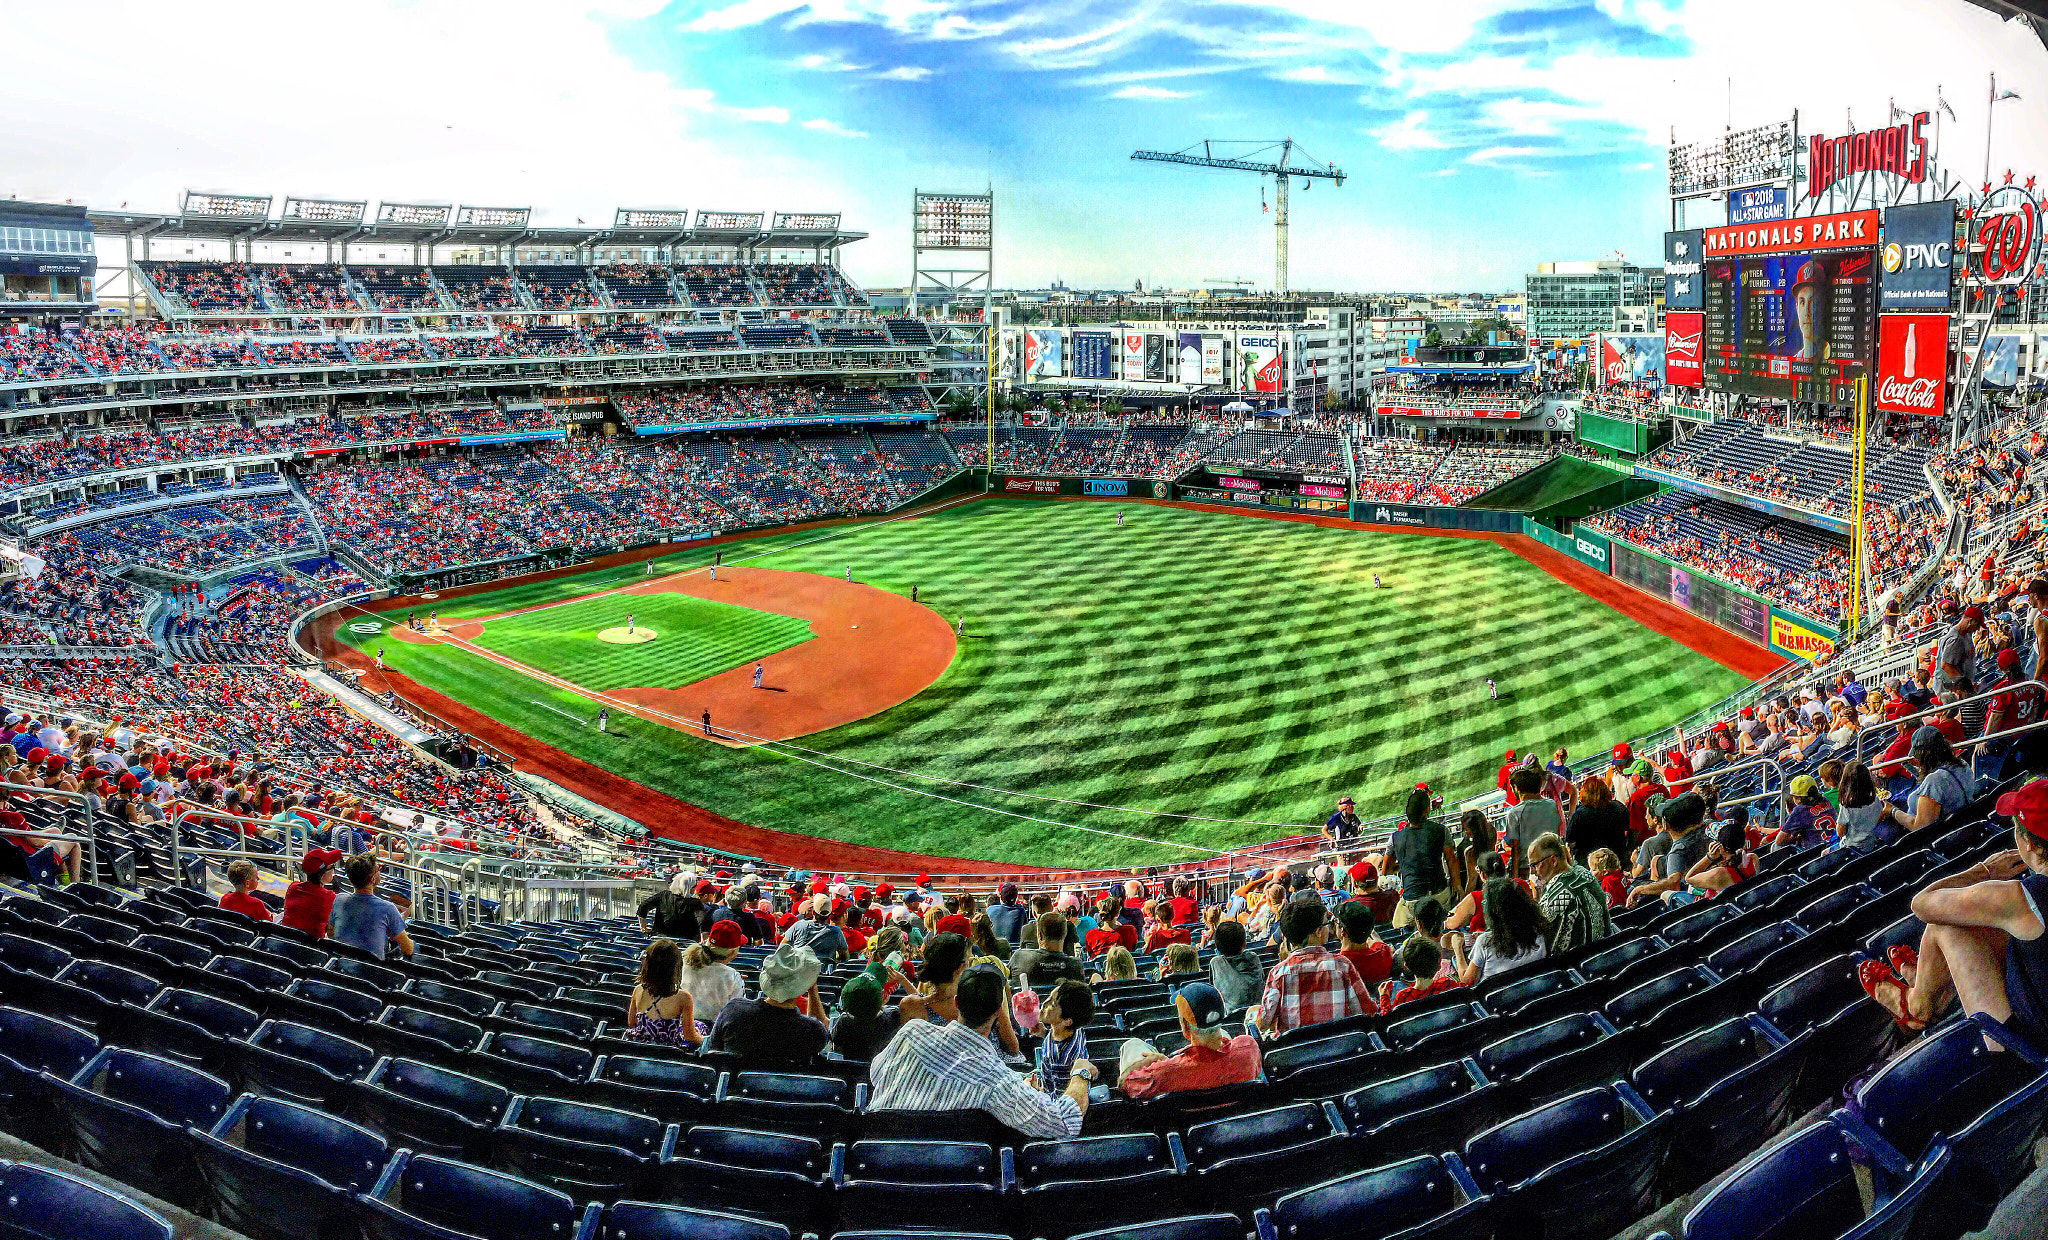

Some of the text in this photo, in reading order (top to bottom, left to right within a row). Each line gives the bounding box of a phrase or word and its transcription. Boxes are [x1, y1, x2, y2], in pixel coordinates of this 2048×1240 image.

[1809, 111, 1930, 198] NATIONALS
[1754, 188, 1774, 206] 2018
[1764, 204, 1784, 218] GAME
[1708, 218, 1866, 250] NATIONALS PARK
[1904, 242, 1950, 269] PNC
[1884, 290, 1900, 298] Official
[1901, 290, 1912, 298] Bank
[1912, 290, 1917, 299] of
[1925, 290, 1948, 298] Nationals
[1839, 388, 1855, 401] 0 2
[1880, 375, 1940, 409] Coca-Cola
[573, 412, 591, 420] ISLAND
[1094, 483, 1128, 493] INOVA
[1576, 537, 1606, 562] GEICO
[1774, 620, 1783, 629] WHO
